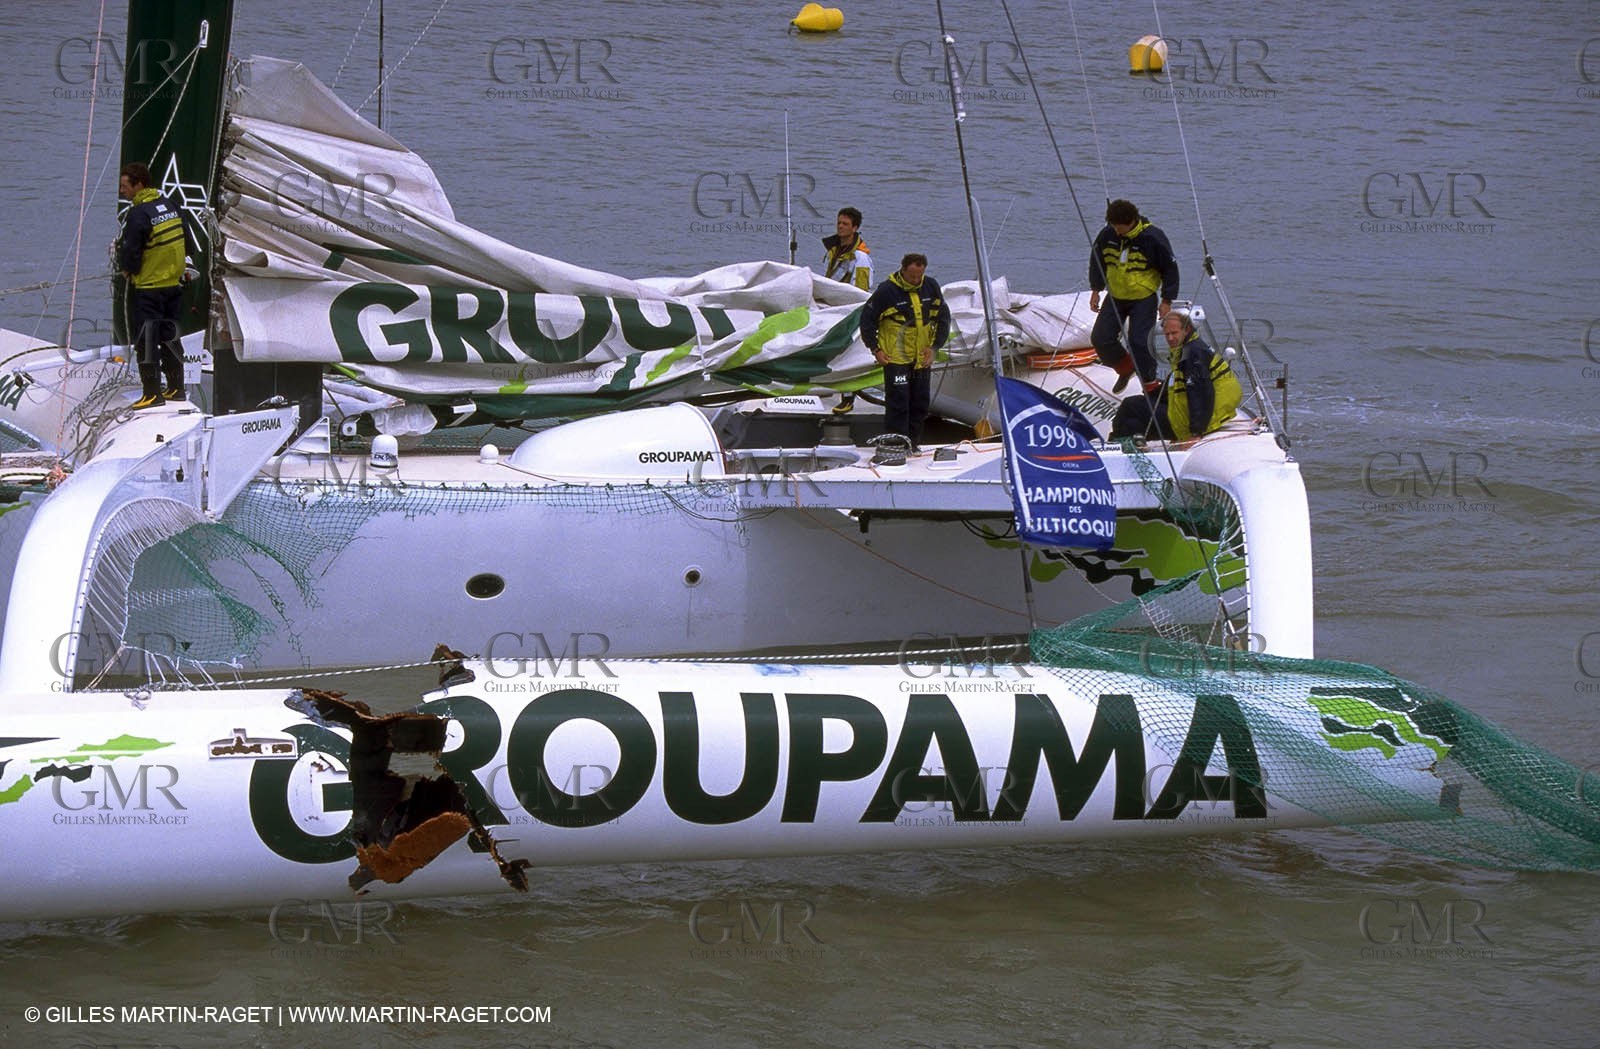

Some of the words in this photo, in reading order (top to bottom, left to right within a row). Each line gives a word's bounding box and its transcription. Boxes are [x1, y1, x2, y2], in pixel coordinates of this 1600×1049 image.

[774, 397, 815, 405] GROUPAMA
[242, 418, 281, 434] GROUPAMA
[1025, 424, 1077, 449] 1998
[639, 451, 714, 464] GROUPAMA
[1024, 487, 1116, 506] HAMPIONN
[1026, 518, 1116, 537] ULTICOQU
[249, 691, 1267, 864] GROUPAMA
